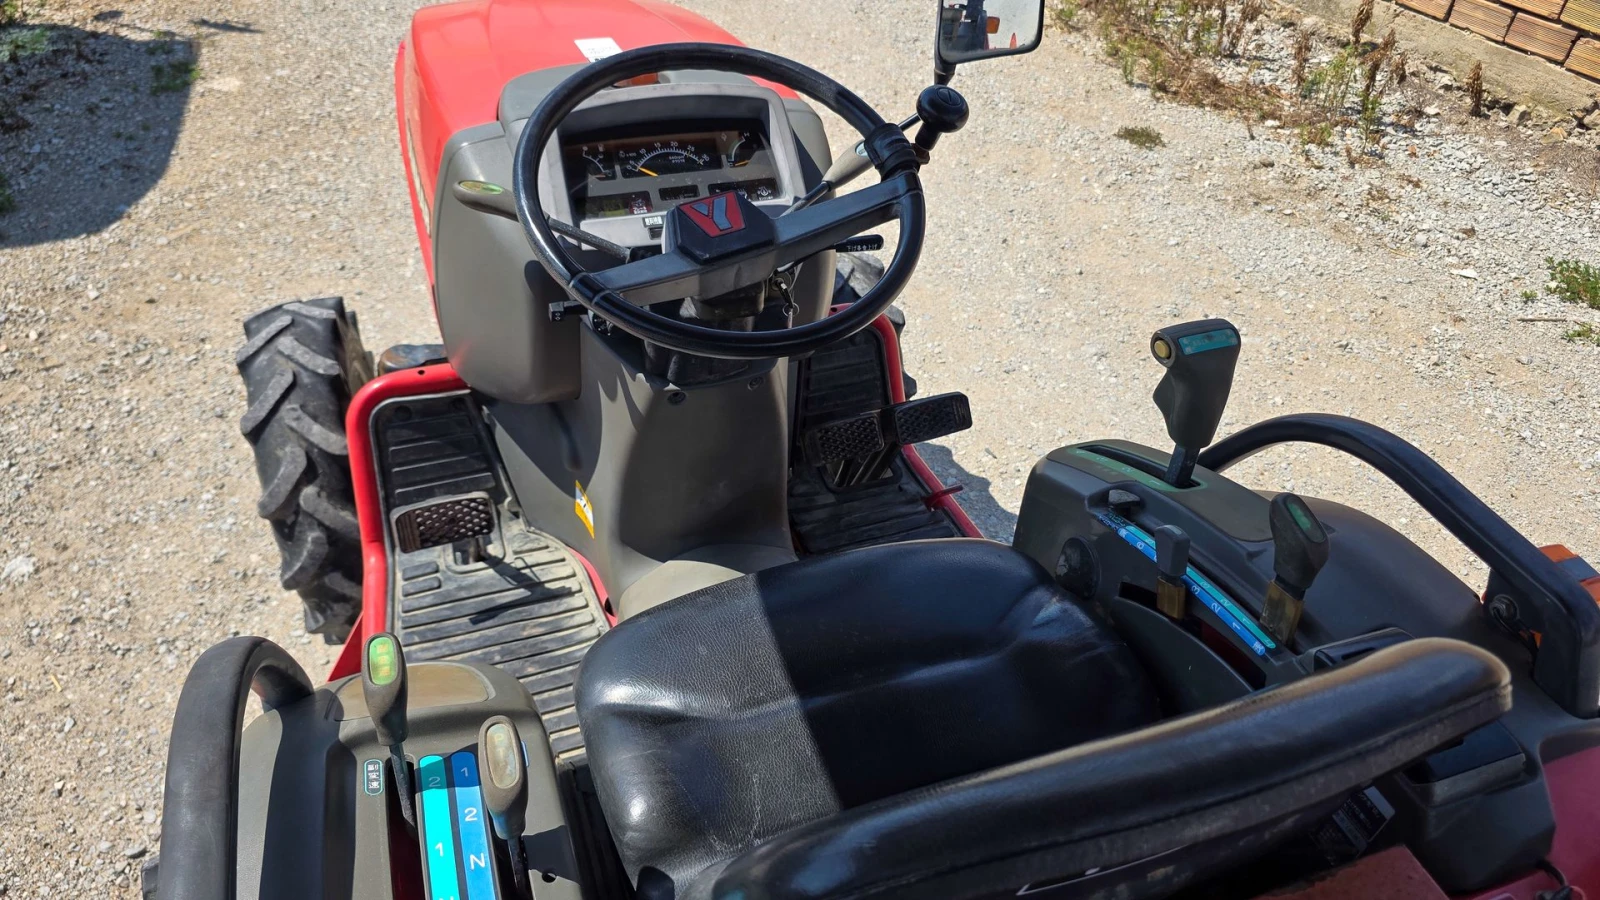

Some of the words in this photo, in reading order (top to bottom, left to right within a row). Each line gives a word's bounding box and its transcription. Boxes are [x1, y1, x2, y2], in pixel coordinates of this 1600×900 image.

[1191, 585, 1200, 594] 3
[1211, 602, 1221, 613] 2
[1232, 621, 1241, 630] 1
[460, 767, 469, 777] 1
[428, 776, 441, 788] 2
[464, 807, 478, 822] 2
[434, 842, 444, 857] 1
[469, 852, 486, 870] N
